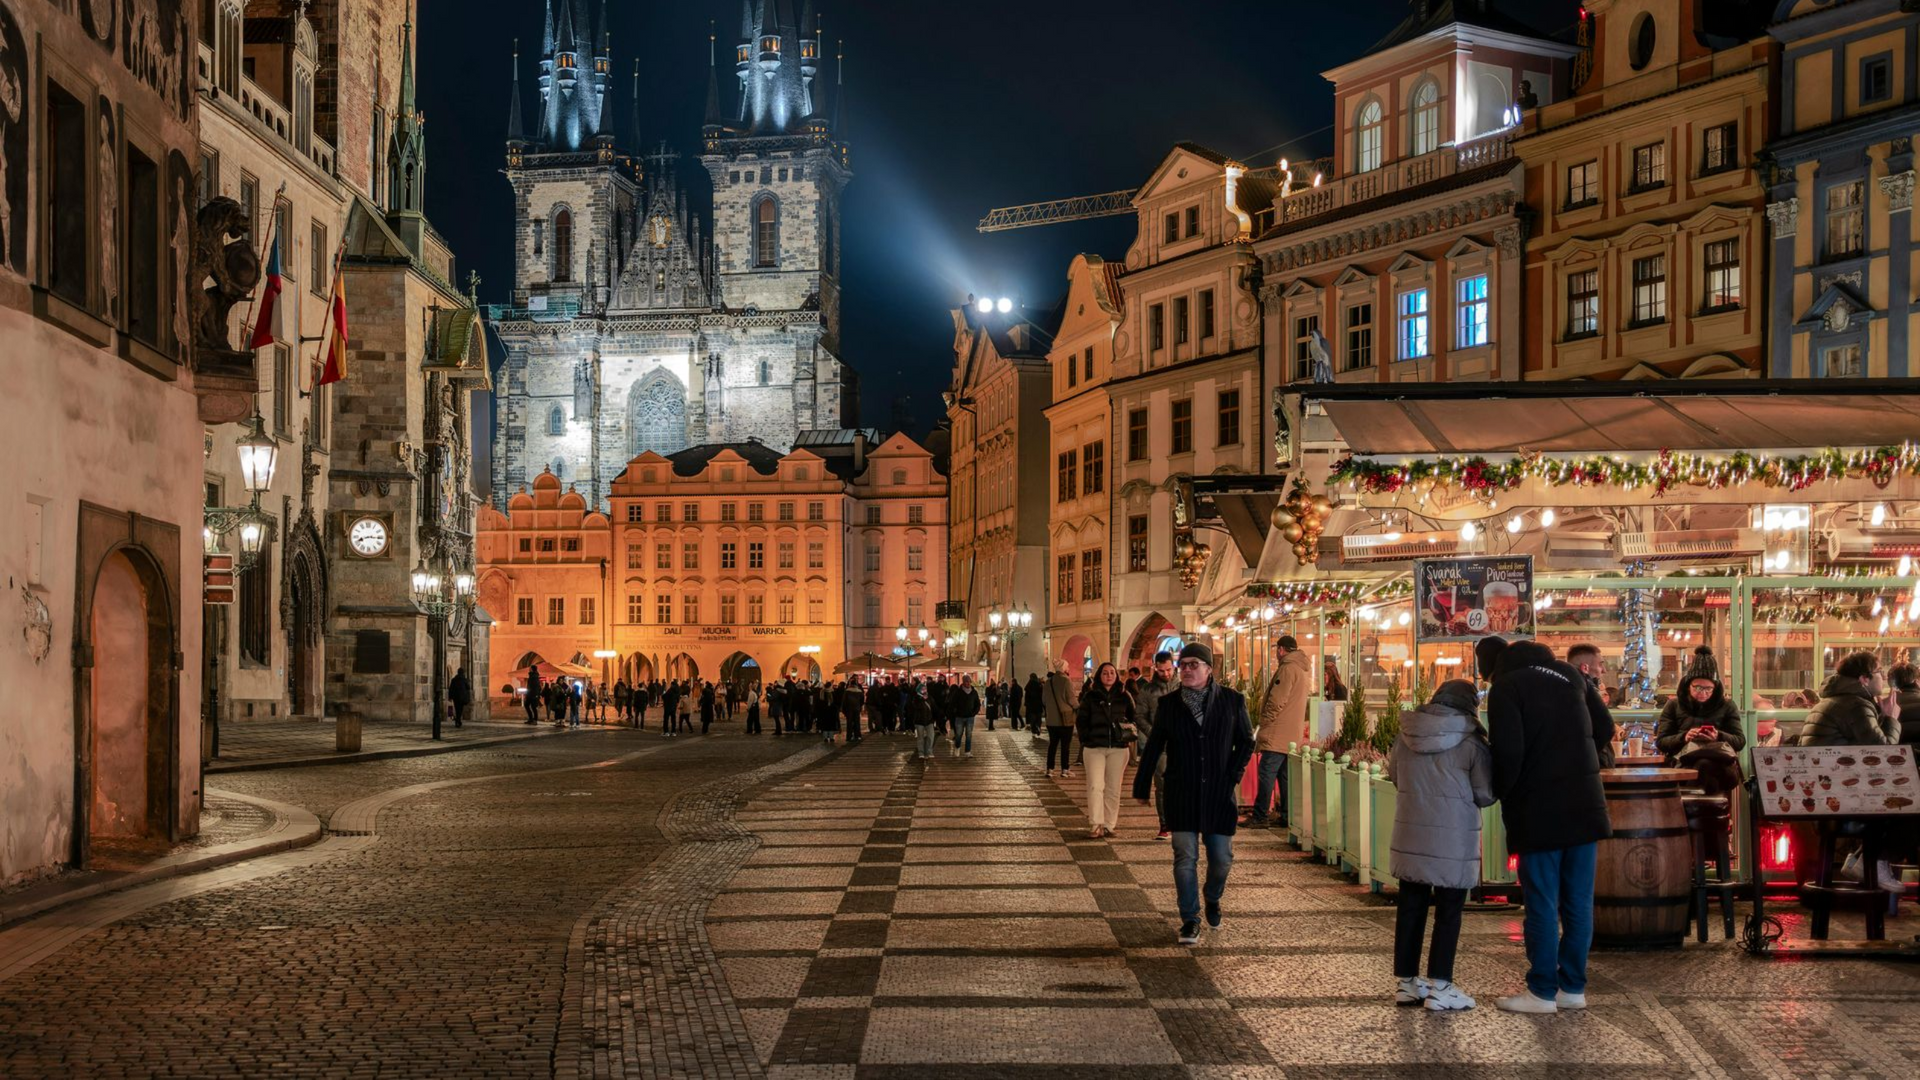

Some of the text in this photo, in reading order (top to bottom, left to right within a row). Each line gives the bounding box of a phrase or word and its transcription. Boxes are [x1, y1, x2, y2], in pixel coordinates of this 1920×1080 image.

[1486, 566, 1506, 581] Pivo
[702, 627, 731, 635] MUCHA
[752, 627, 787, 635] WARHOL
